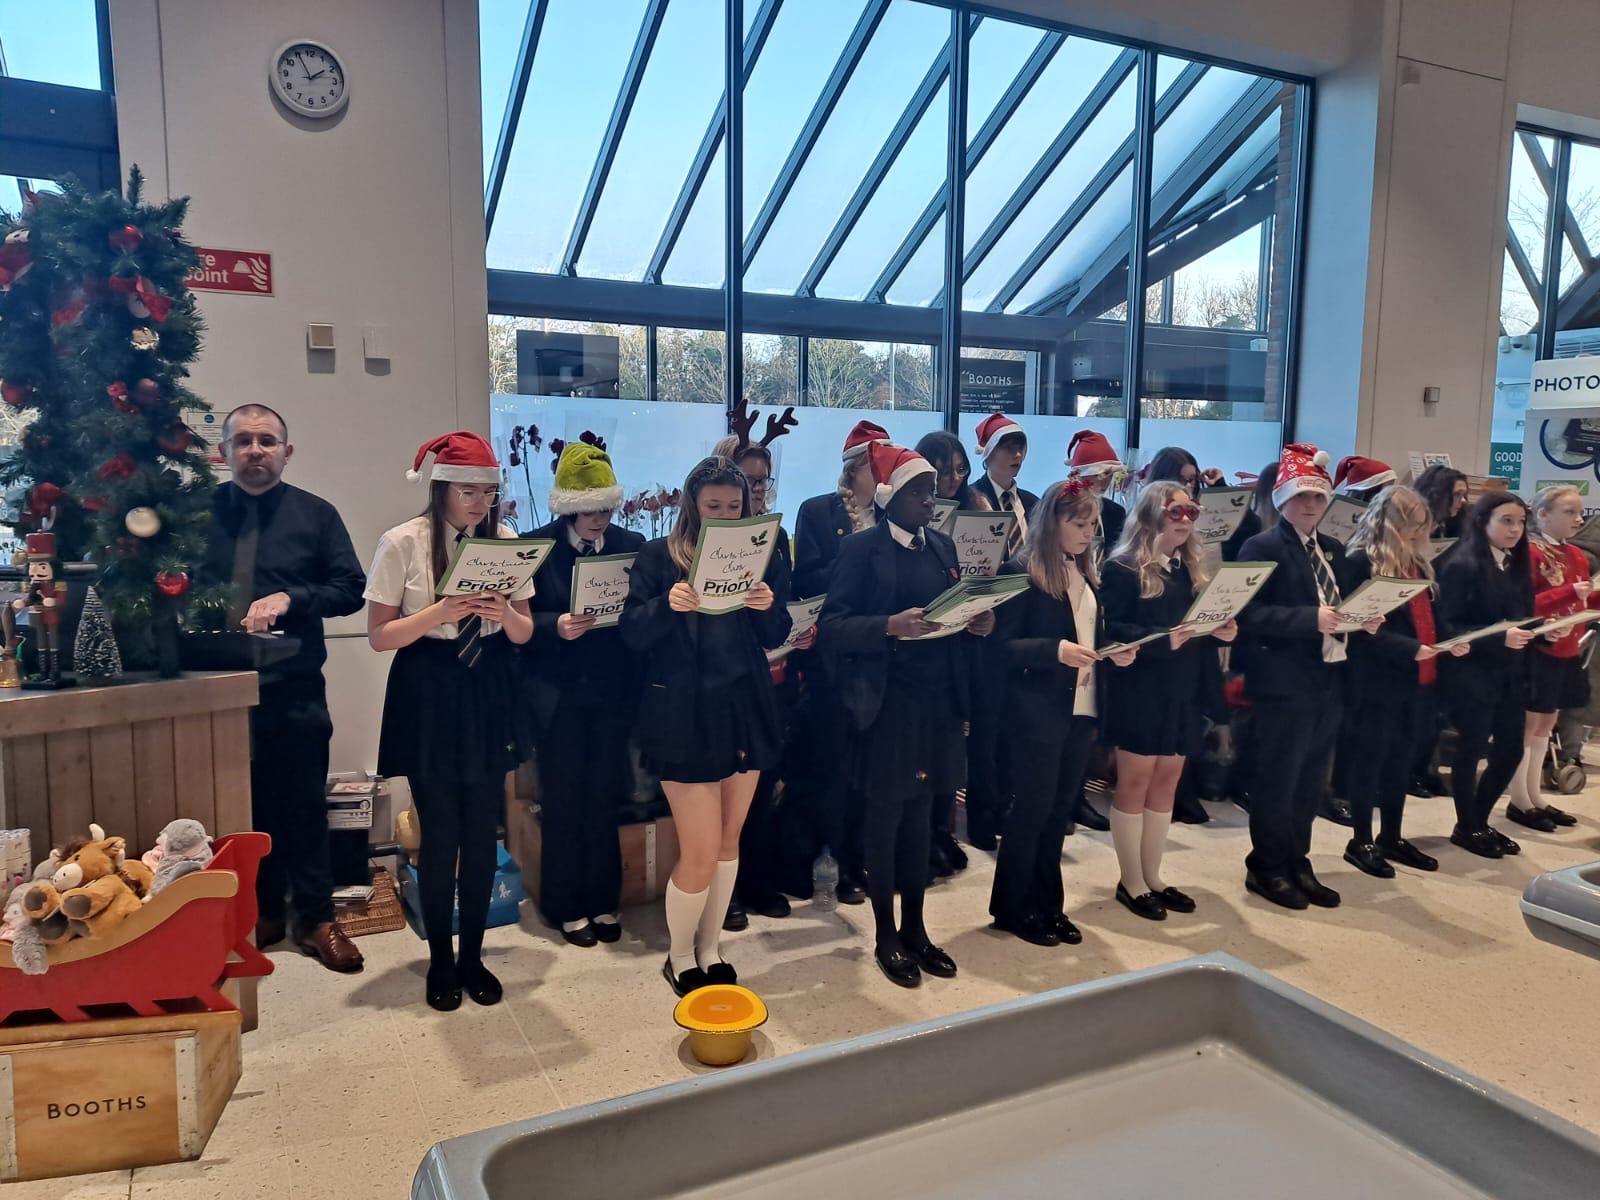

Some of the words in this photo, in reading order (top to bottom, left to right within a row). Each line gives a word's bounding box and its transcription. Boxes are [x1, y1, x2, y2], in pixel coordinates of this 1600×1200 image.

[305, 50, 315, 58] 12
[286, 58, 294, 66] 10
[283, 69, 288, 77] 9
[329, 65, 335, 73] 2
[286, 82, 292, 90] 8
[308, 97, 314, 105] 6
[320, 96, 326, 104] 5
[969, 373, 1012, 386] BOOTHS
[1534, 375, 1600, 393] PHOTO
[1494, 451, 1523, 462] GOOD
[960, 563, 992, 575] riory
[457, 580, 518, 591] Priory
[703, 578, 754, 594] Priory
[583, 603, 625, 616] Prior
[47, 1096, 147, 1119] BOOTHS
